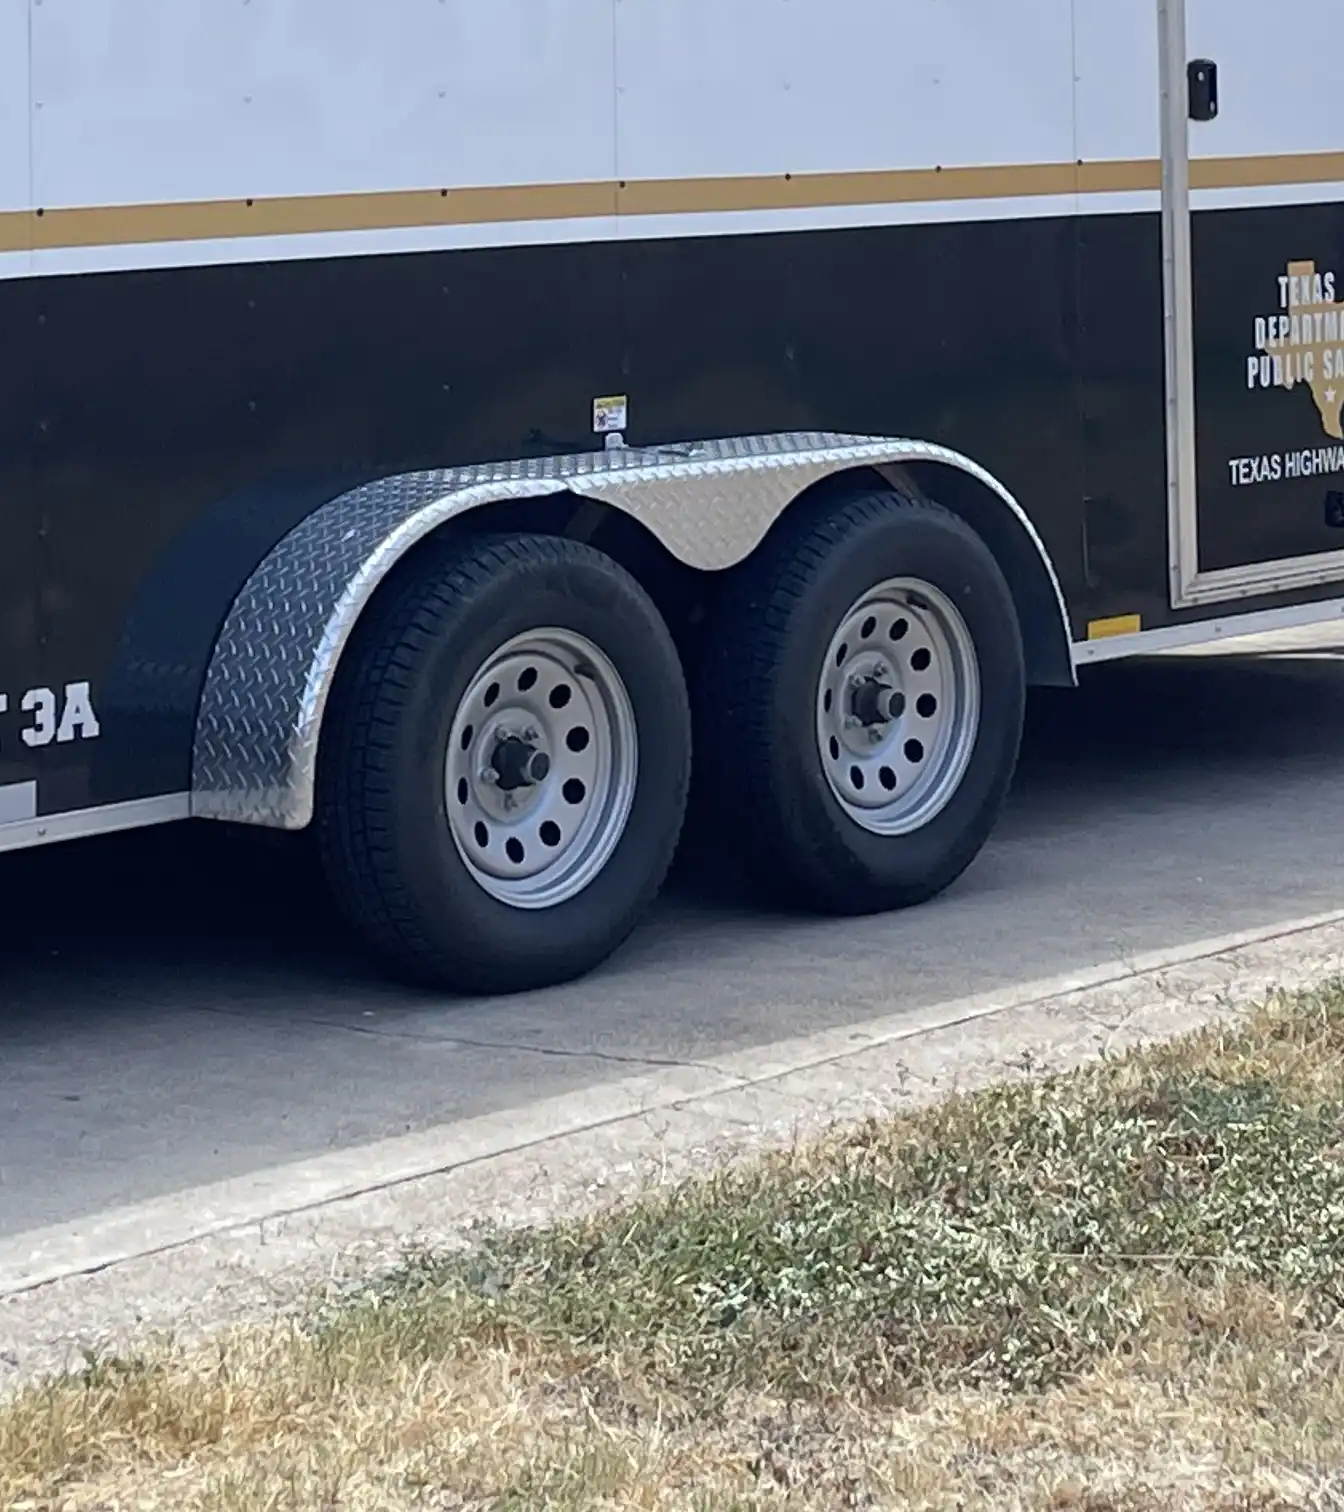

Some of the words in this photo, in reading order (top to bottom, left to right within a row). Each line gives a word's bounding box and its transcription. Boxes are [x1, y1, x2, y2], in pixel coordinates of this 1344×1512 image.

[1277, 271, 1336, 308] TEXAS
[1247, 351, 1315, 389] PUBLIC
[1228, 453, 1282, 486] TEXAS
[21, 681, 101, 748] 3A
